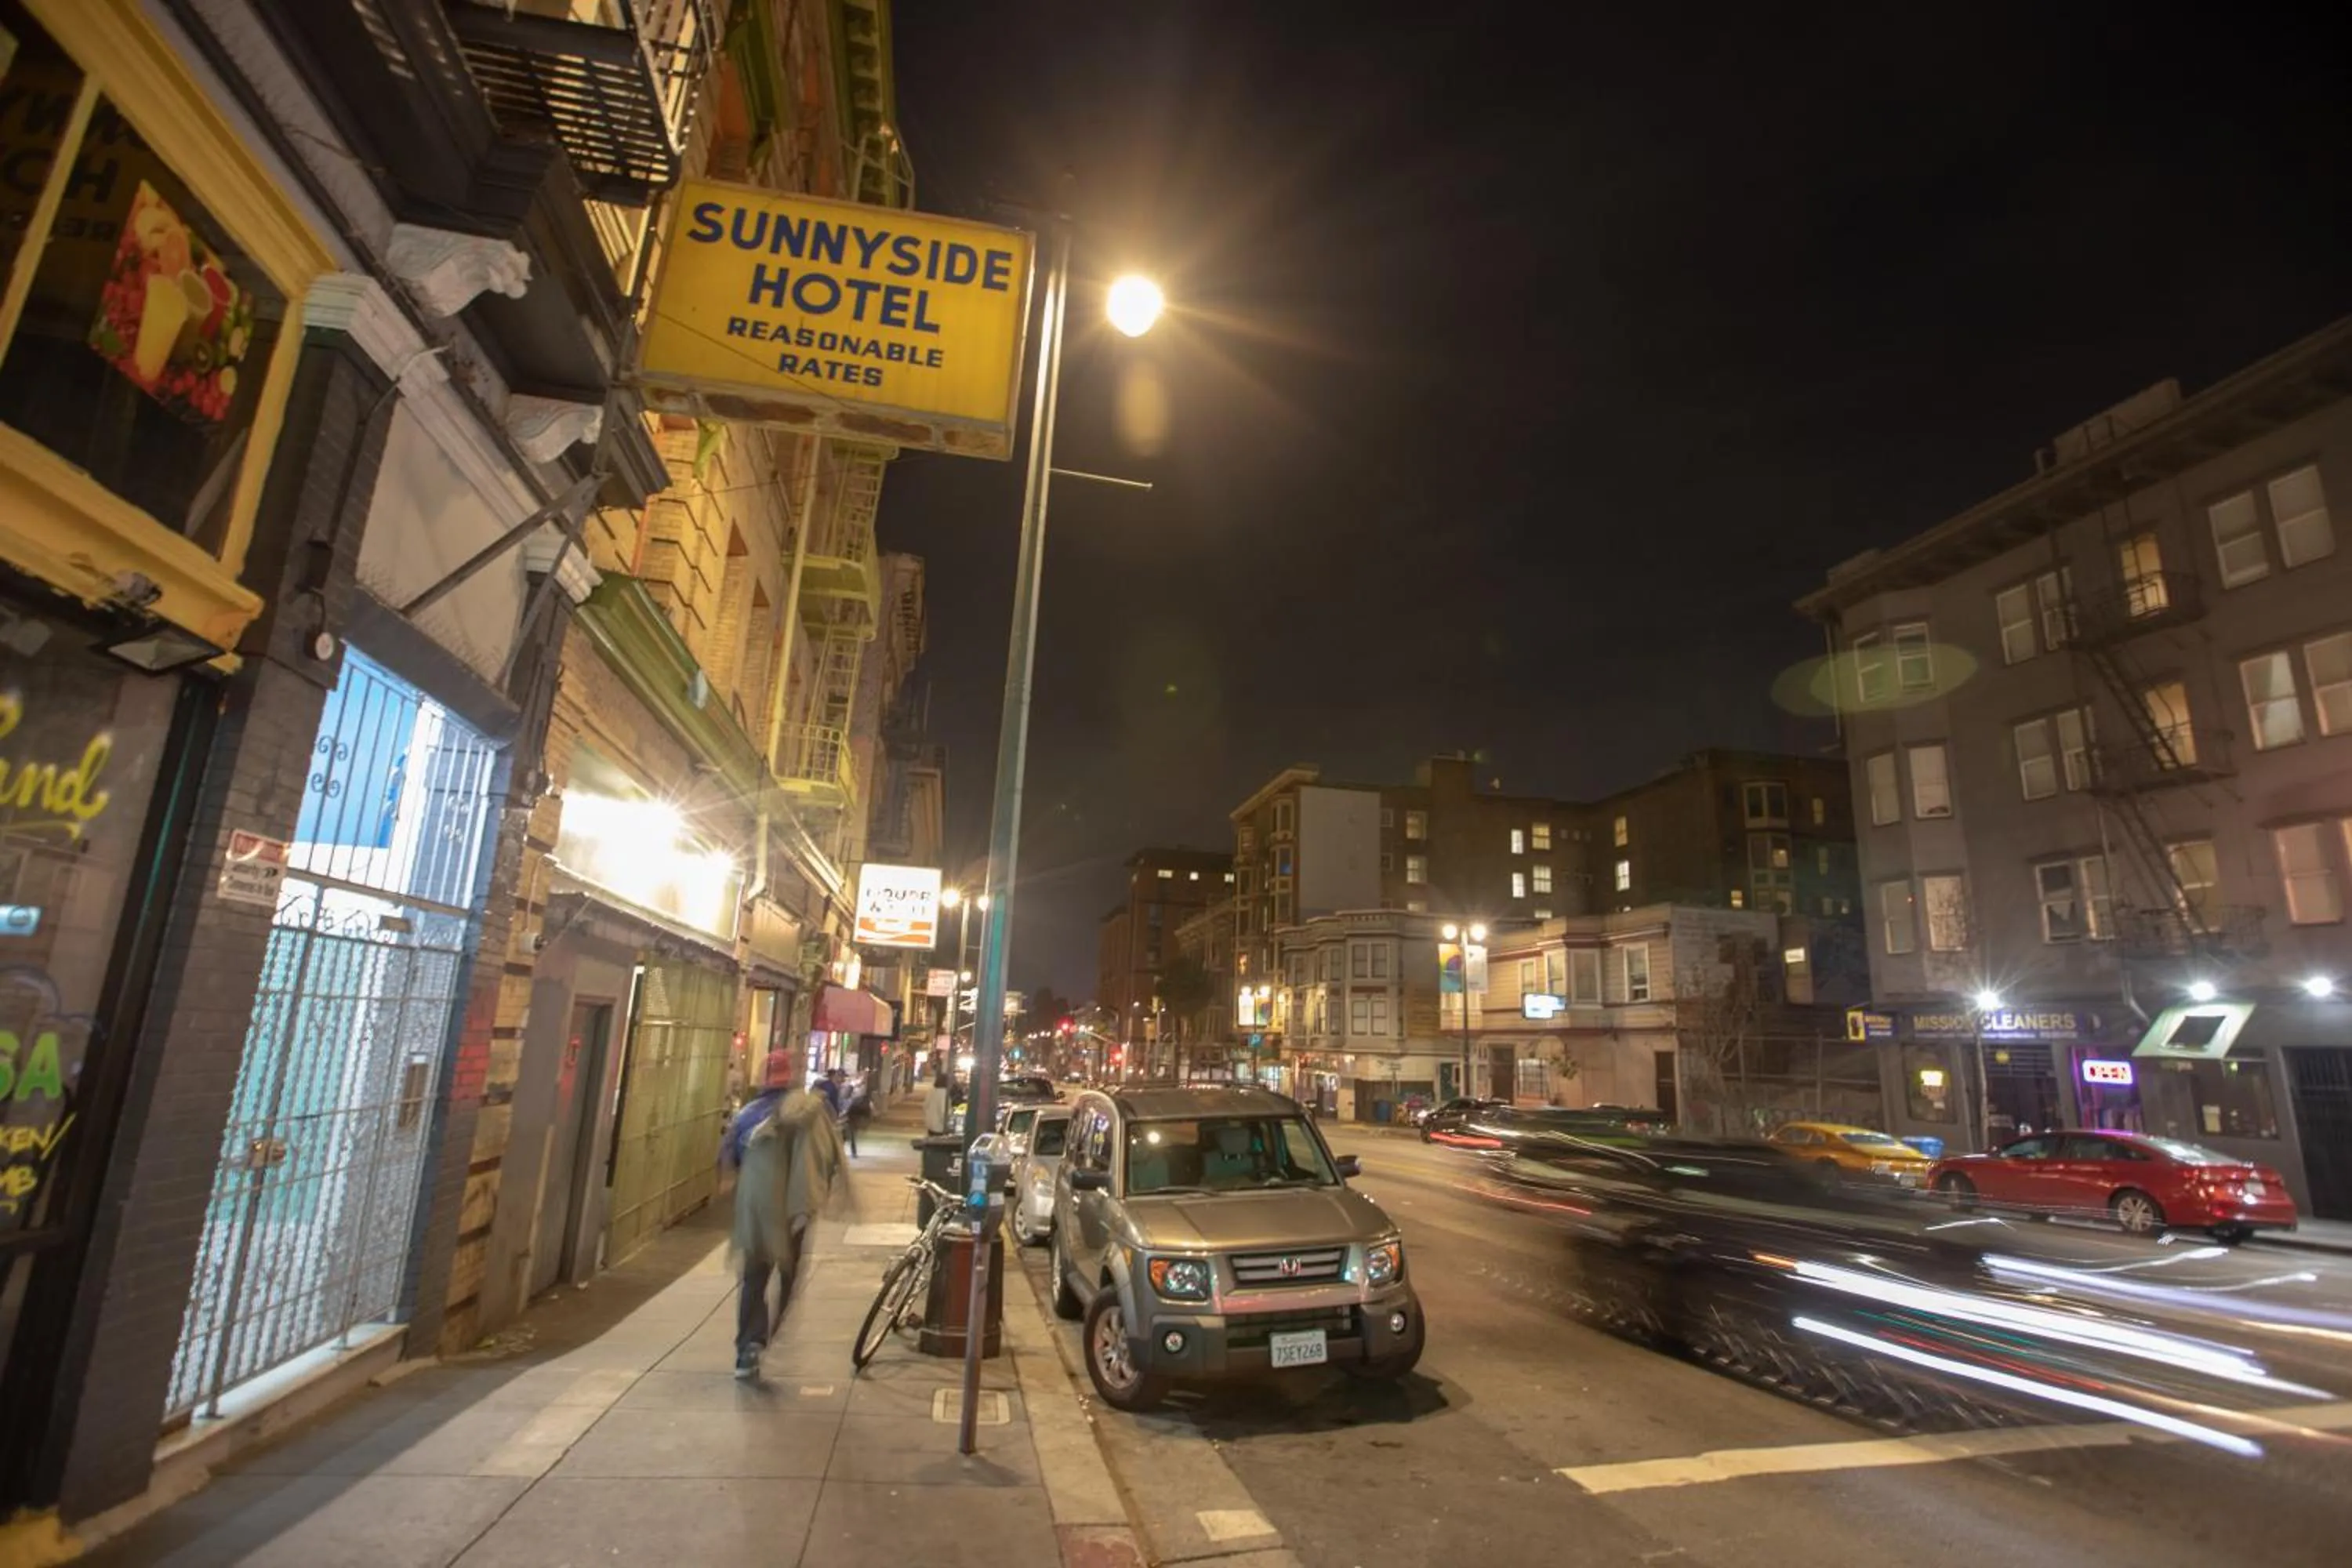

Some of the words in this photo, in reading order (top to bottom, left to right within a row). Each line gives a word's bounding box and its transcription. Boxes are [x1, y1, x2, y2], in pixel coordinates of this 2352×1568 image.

[687, 201, 1013, 292] SUNNYSIDE
[749, 263, 940, 334] HOTEL
[727, 316, 945, 369] REASONABLE
[778, 352, 883, 387] RATES
[1980, 1012, 2076, 1031] CLEANERS
